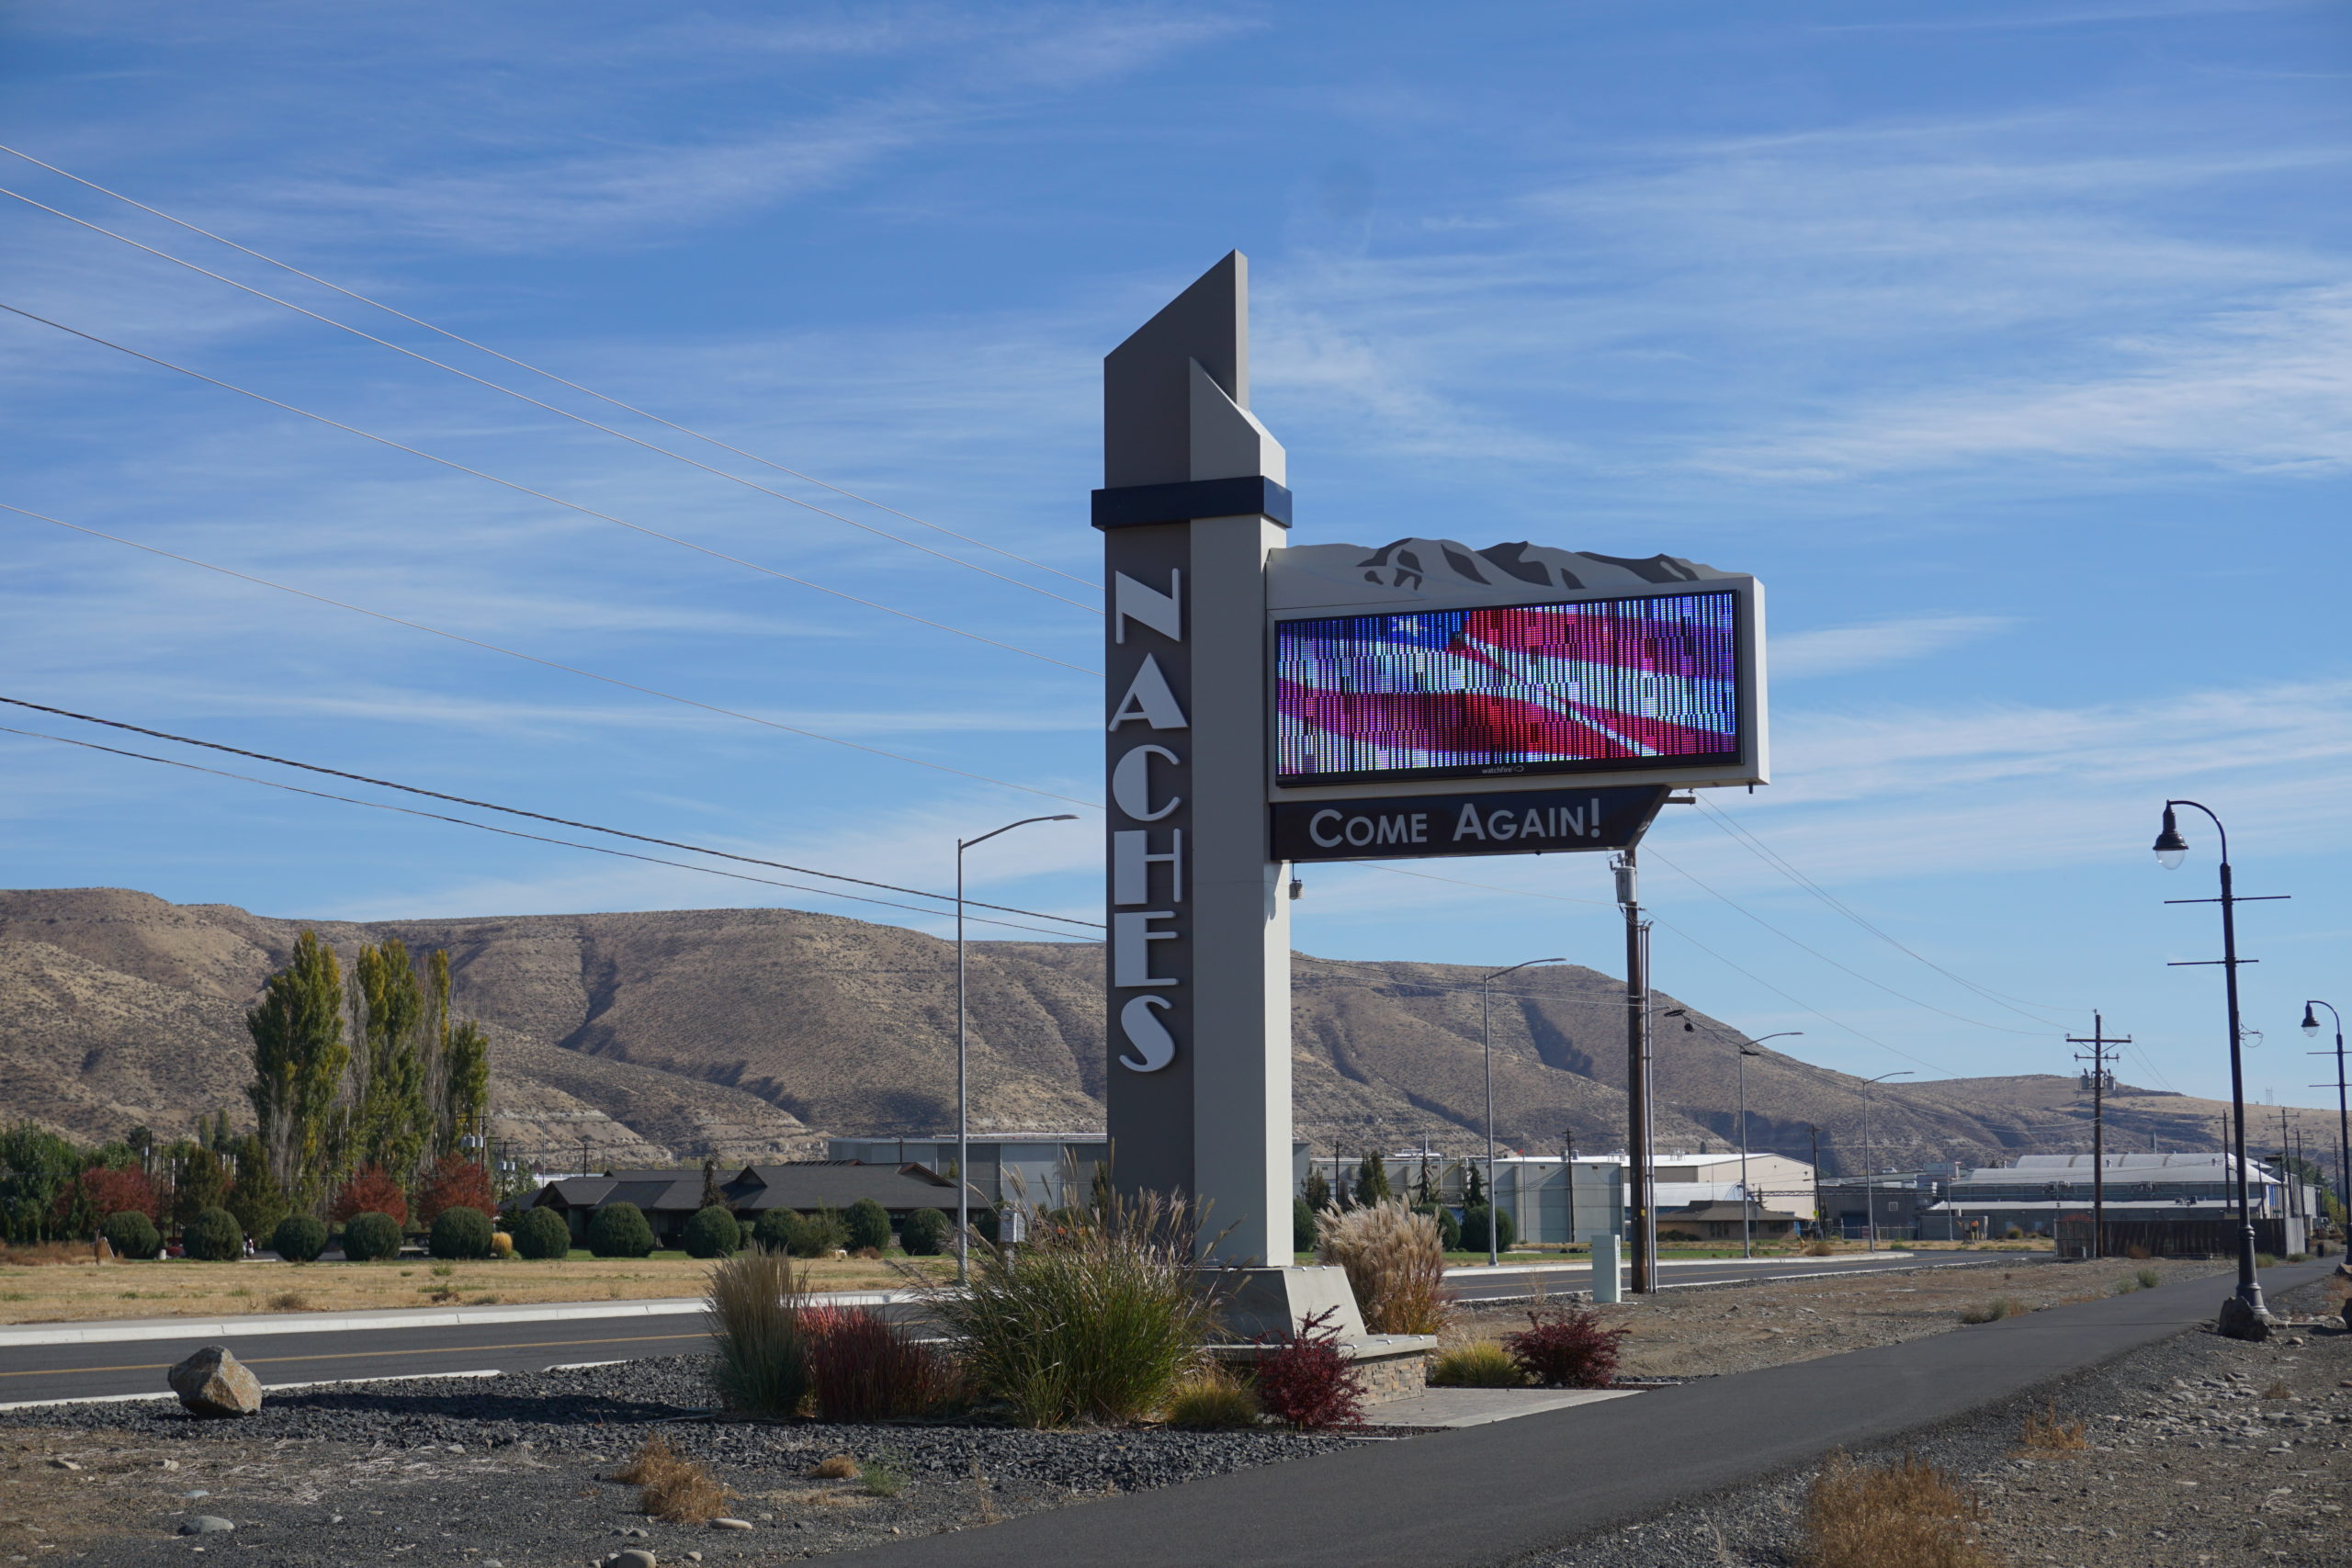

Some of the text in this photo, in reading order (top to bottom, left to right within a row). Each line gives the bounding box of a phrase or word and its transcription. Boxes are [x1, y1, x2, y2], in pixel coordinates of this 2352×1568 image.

[1108, 568, 1189, 1073] NACHES
[1309, 797, 1601, 848] COME AGAIN!
